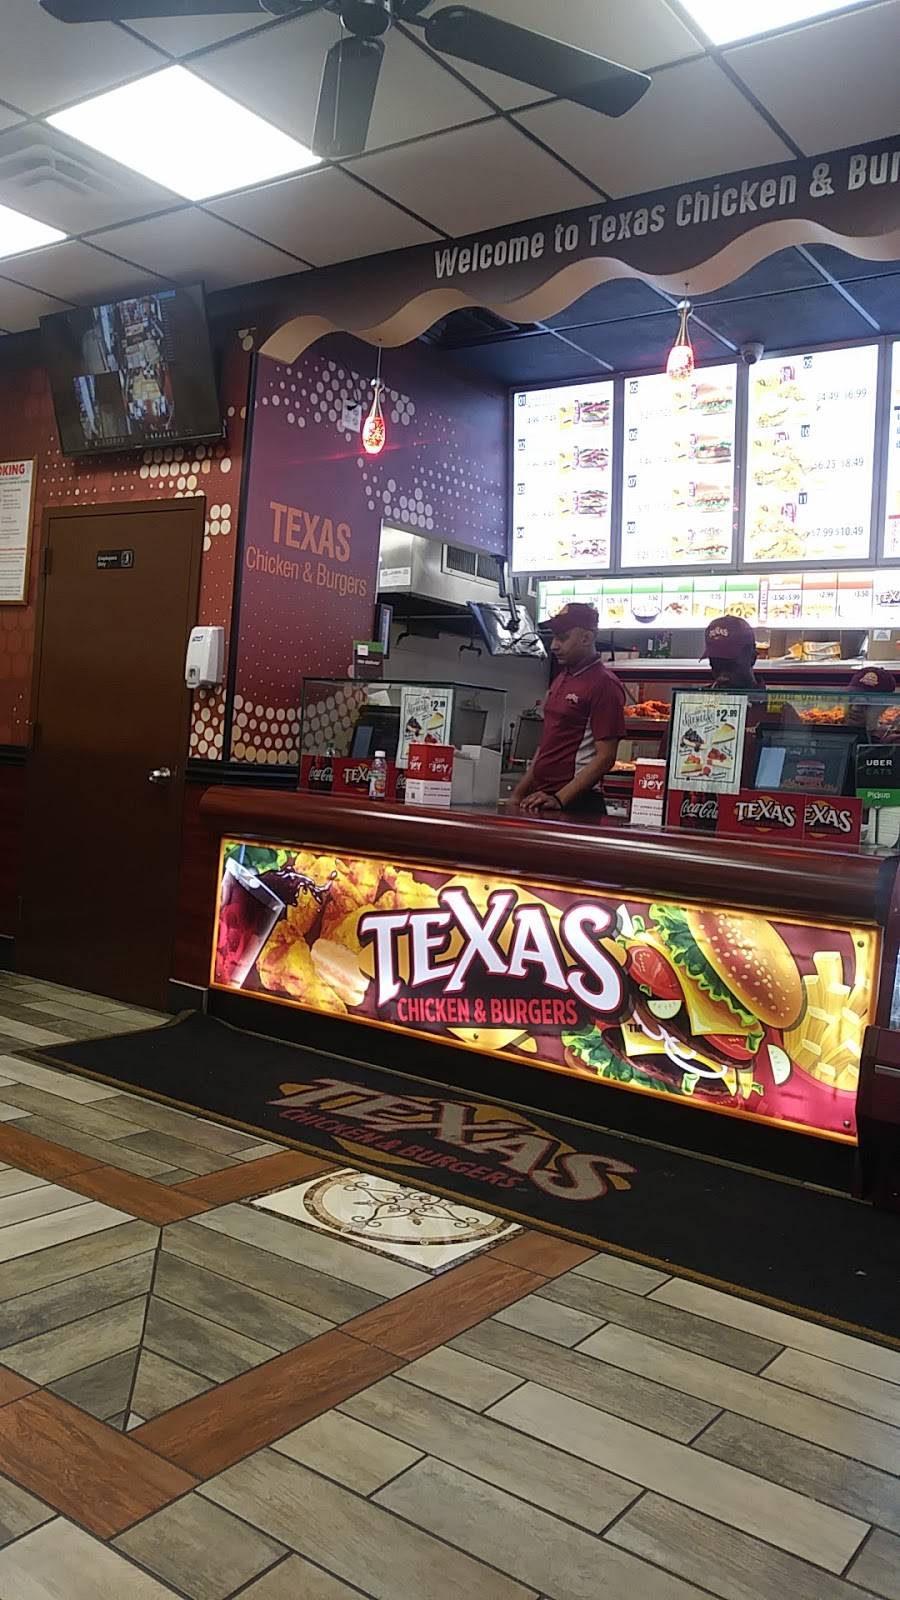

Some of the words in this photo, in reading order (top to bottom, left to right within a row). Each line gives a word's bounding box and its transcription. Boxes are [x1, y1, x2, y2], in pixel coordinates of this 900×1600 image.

[435, 231, 544, 279] Welcome
[554, 223, 579, 254] to
[588, 202, 666, 246] Texas
[676, 174, 796, 227] Chicken
[809, 162, 835, 198] &
[270, 501, 351, 561] TEXAS
[246, 546, 299, 579] Chicken
[302, 562, 312, 583] &
[316, 563, 367, 596] Burgers
[717, 709, 737, 722] $2.99
[735, 799, 795, 828] TEXAS
[359, 888, 622, 1014] TEXAS
[397, 998, 469, 1022] CHICKEN
[473, 1000, 487, 1020] &
[490, 998, 578, 1024] BURGERS
[268, 1078, 635, 1200] TEXAS
[280, 1109, 380, 1143] CHICKEN
[402, 1142, 517, 1189] BURGERS
